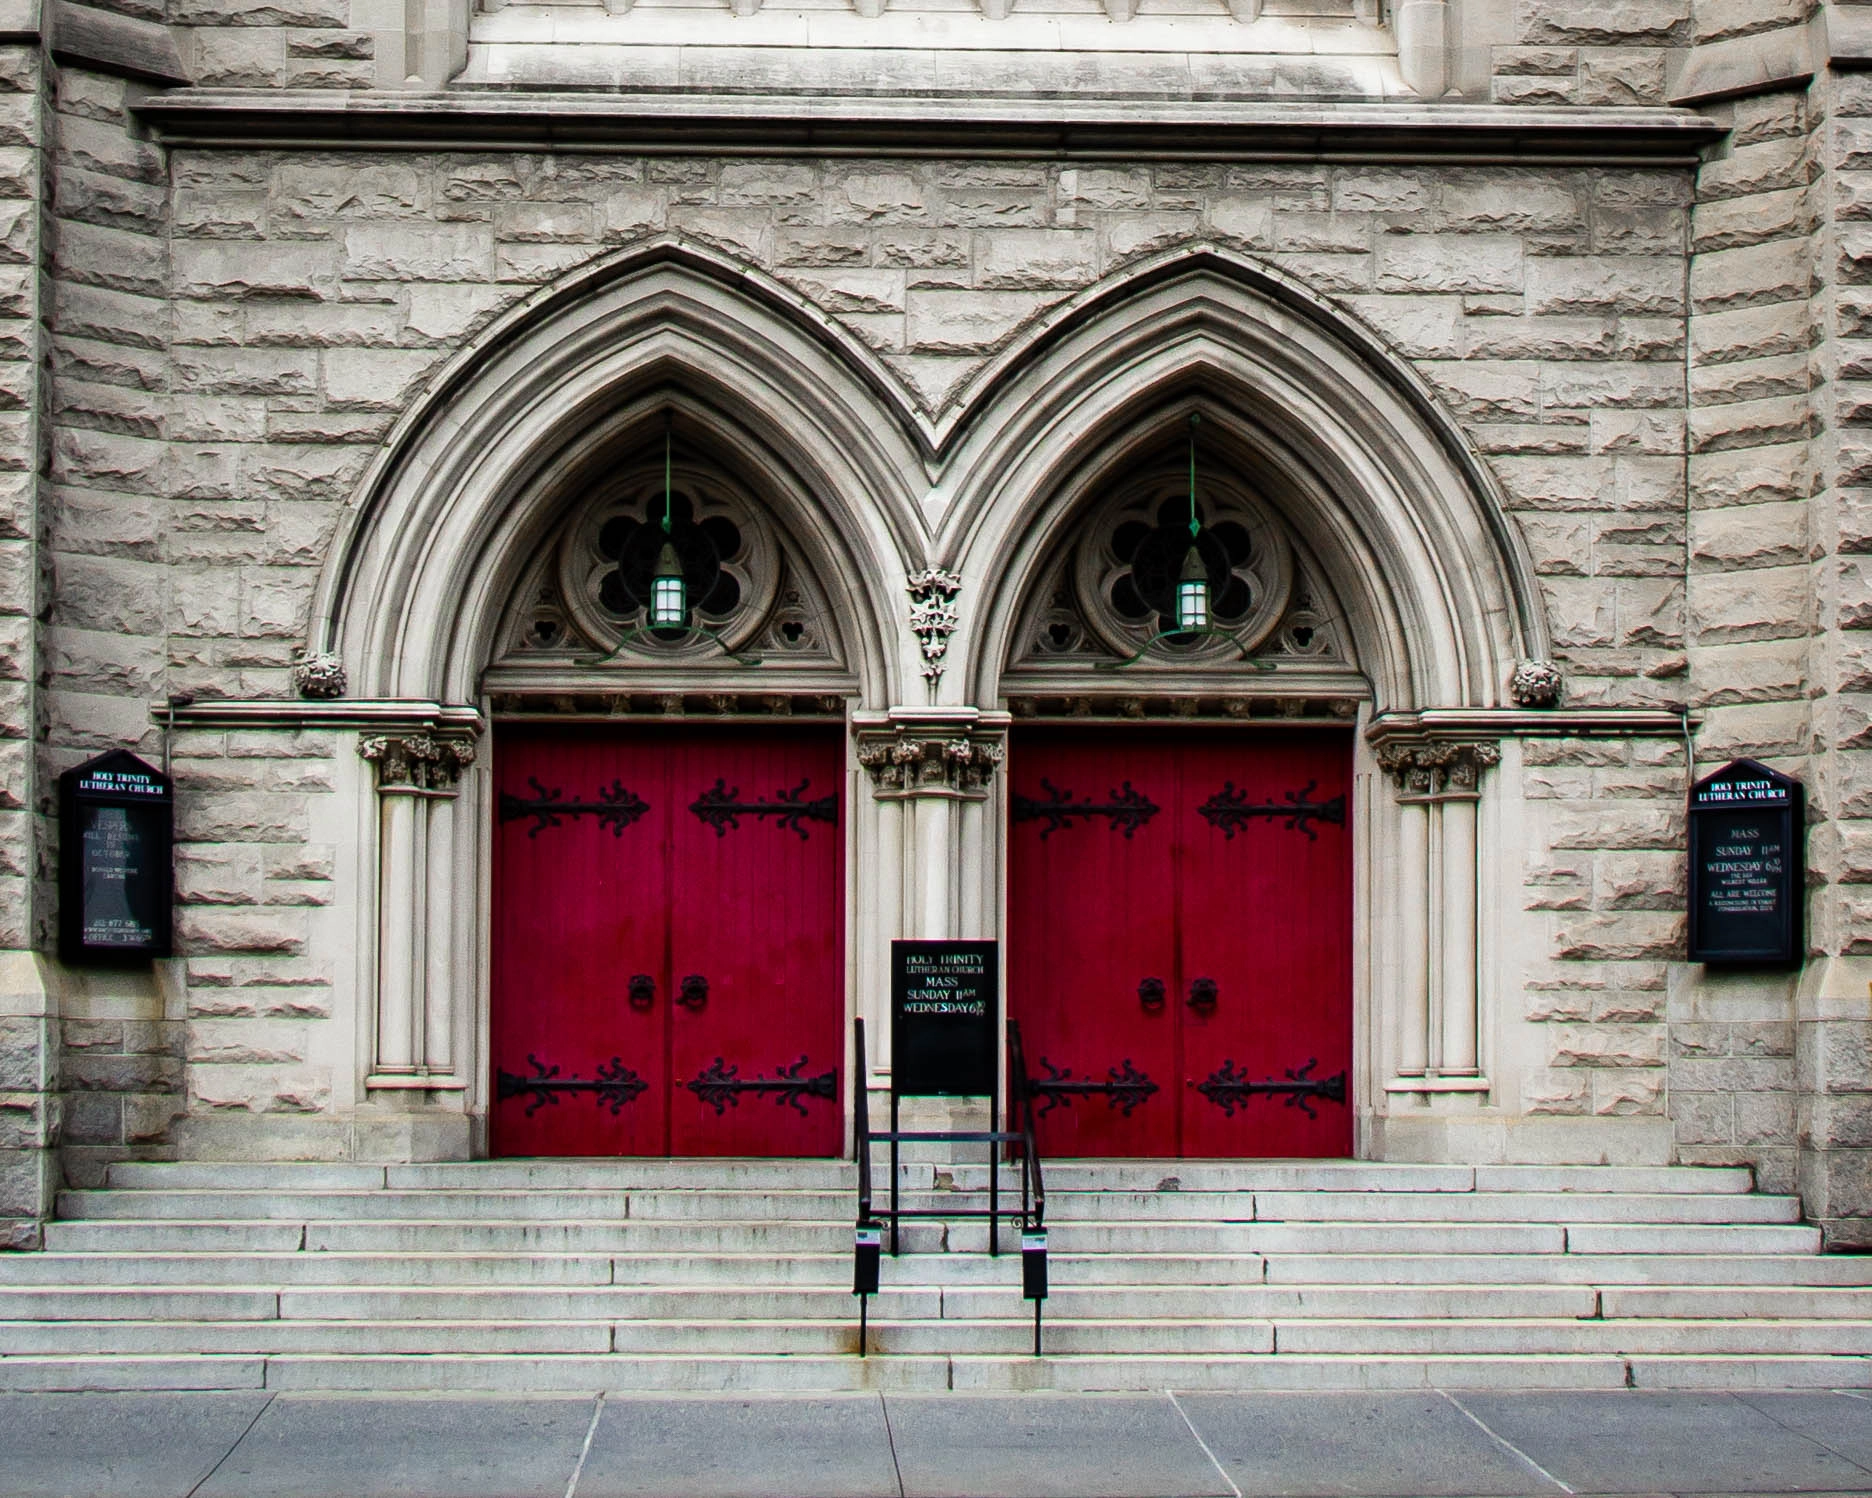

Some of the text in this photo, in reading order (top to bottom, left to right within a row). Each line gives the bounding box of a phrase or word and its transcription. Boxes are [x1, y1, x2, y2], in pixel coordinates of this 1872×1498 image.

[92, 771, 151, 784] HOLY TRINITY
[80, 780, 164, 794] LUTHERAN CHURCH
[1711, 781, 1772, 791] HOLY TRINITY
[1699, 789, 1786, 801] LUTHERAN CHURCH
[1731, 829, 1760, 839] MASS
[1715, 846, 1753, 856] SUNDAY
[1707, 861, 1762, 872] WEDNESDAY
[906, 954, 984, 965] HOLY TRINITY
[906, 965, 984, 974] LUTHERAN CHURCH
[926, 976, 959, 987] MASS
[907, 989, 950, 1000] SUNDAY
[904, 1002, 968, 1013] WEDNESDAY
